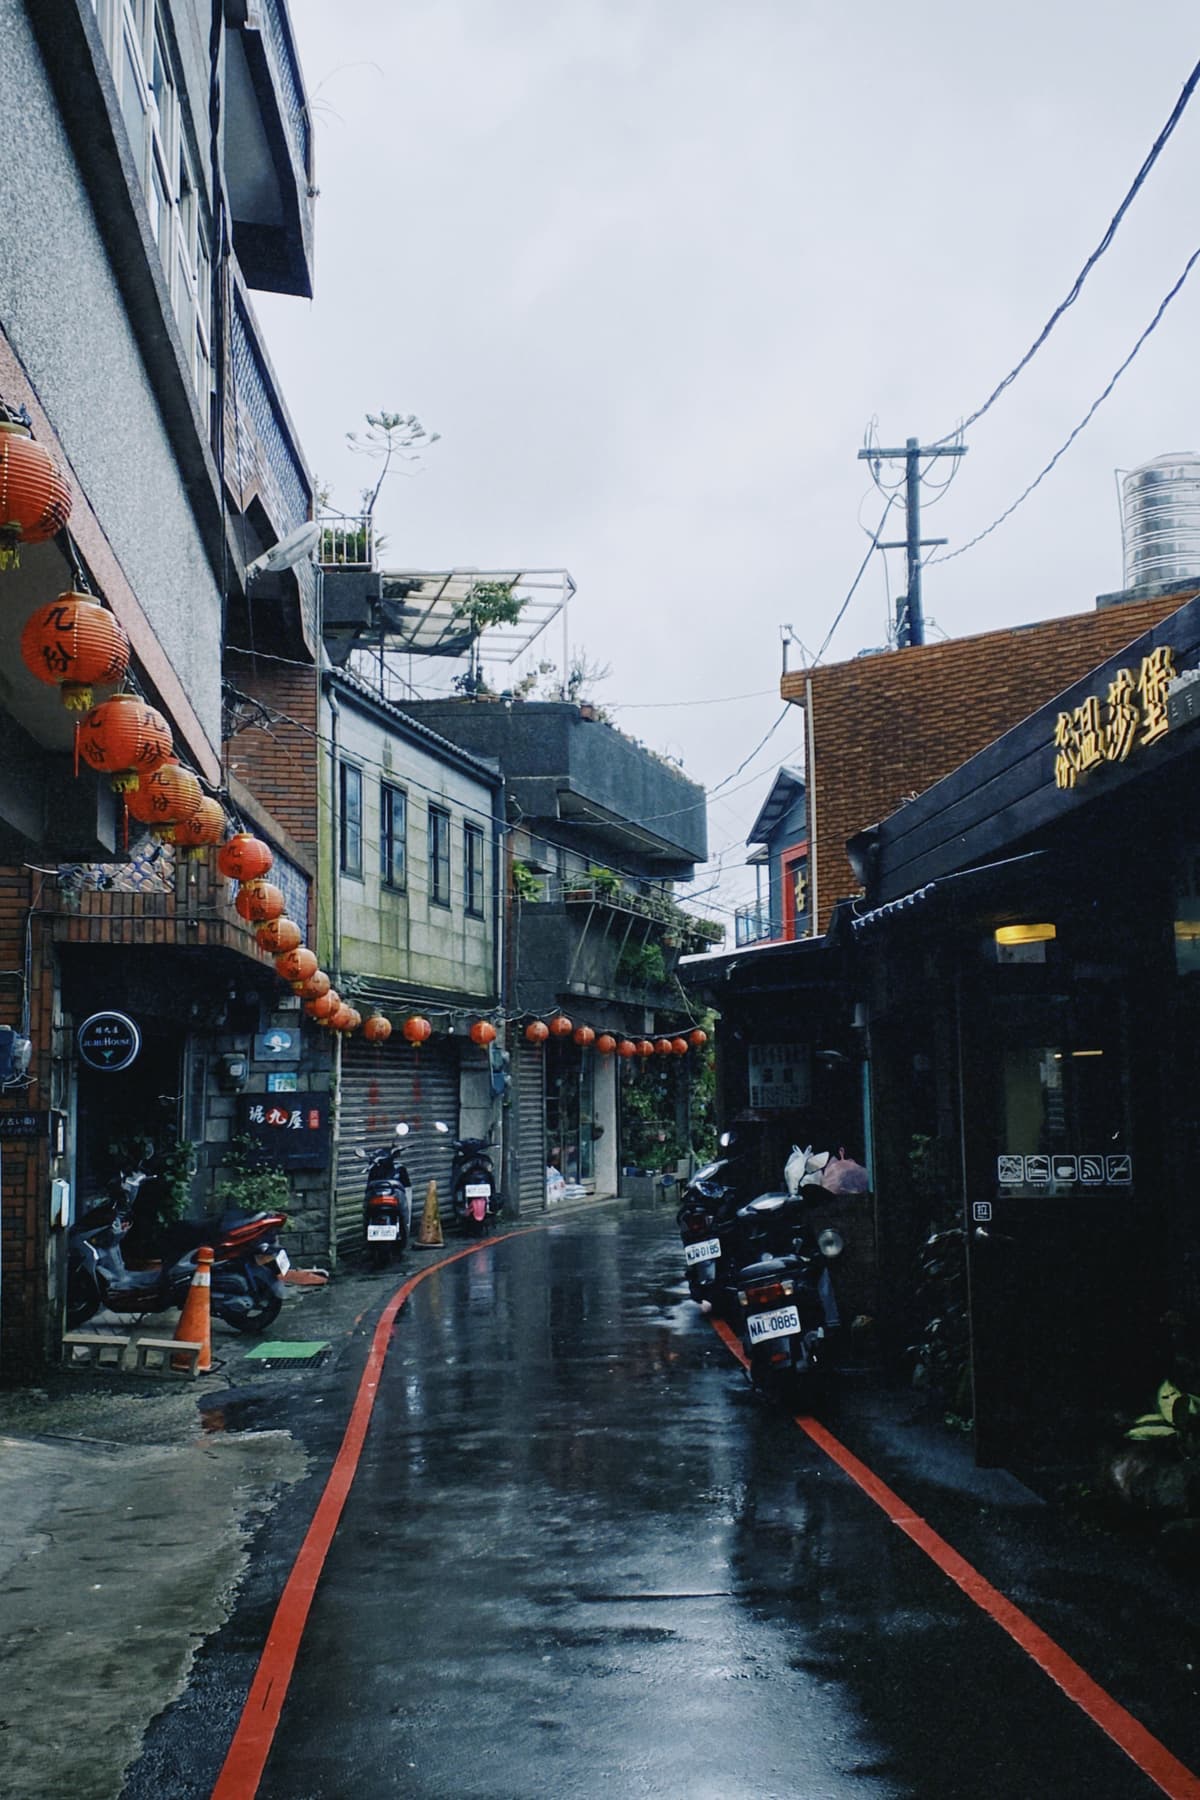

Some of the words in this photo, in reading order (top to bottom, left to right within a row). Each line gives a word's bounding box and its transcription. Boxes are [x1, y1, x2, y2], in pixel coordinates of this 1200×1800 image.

[44, 606, 74, 674] 九份
[85, 709, 106, 763] 九份
[138, 712, 167, 764] 九份
[1075, 645, 1177, 772] 溫莎堡
[1054, 711, 1078, 789] 九份
[149, 772, 170, 812] 九份
